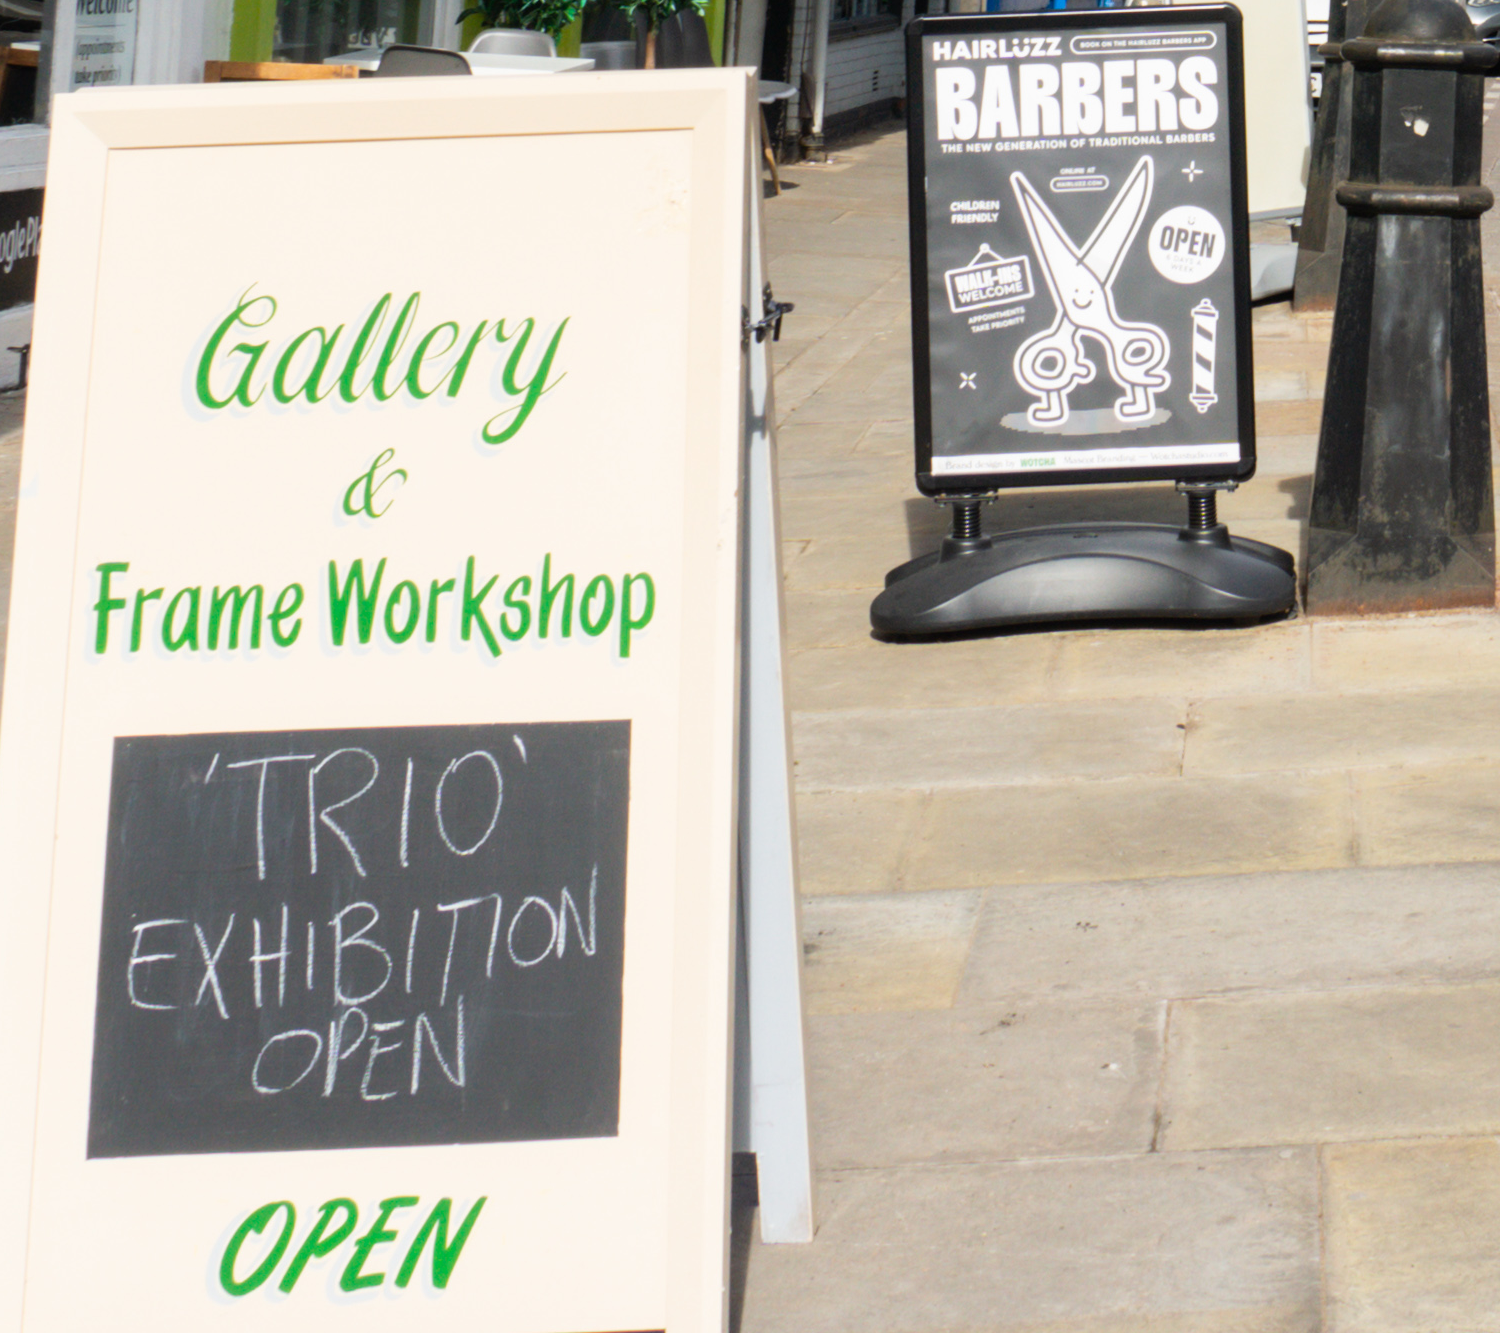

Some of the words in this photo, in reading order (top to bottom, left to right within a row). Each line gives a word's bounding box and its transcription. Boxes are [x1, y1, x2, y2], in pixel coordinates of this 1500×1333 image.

[936, 56, 1218, 140] BARBERS
[942, 144, 963, 153] THE
[966, 143, 992, 152] NEW
[995, 139, 1067, 152] GENERATION
[1071, 138, 1086, 148] OF
[1089, 135, 1163, 147] TRADITIONAL
[1166, 133, 1215, 145] BARBERS
[1087, 166, 1096, 174] AT
[950, 200, 1000, 212] CHILDREN
[951, 213, 999, 224] FRIENDLY
[1159, 225, 1217, 259] OPEN
[955, 264, 1022, 293] WALK-INS
[1171, 264, 1195, 273] WEEK
[958, 282, 1024, 304] WELCOME
[968, 306, 1026, 324] APPOINTMENTS
[971, 323, 989, 333] TAKE
[991, 316, 1025, 330] PRIORITY
[194, 282, 570, 446] Gallery
[1020, 457, 1056, 468] WOTCHA
[341, 447, 409, 521] &
[92, 561, 303, 656] Frame
[328, 553, 656, 658] Workshop
[126, 866, 598, 1018] EXHIBITION
[253, 998, 468, 1101] OPEN
[216, 1196, 488, 1297] OPEN
